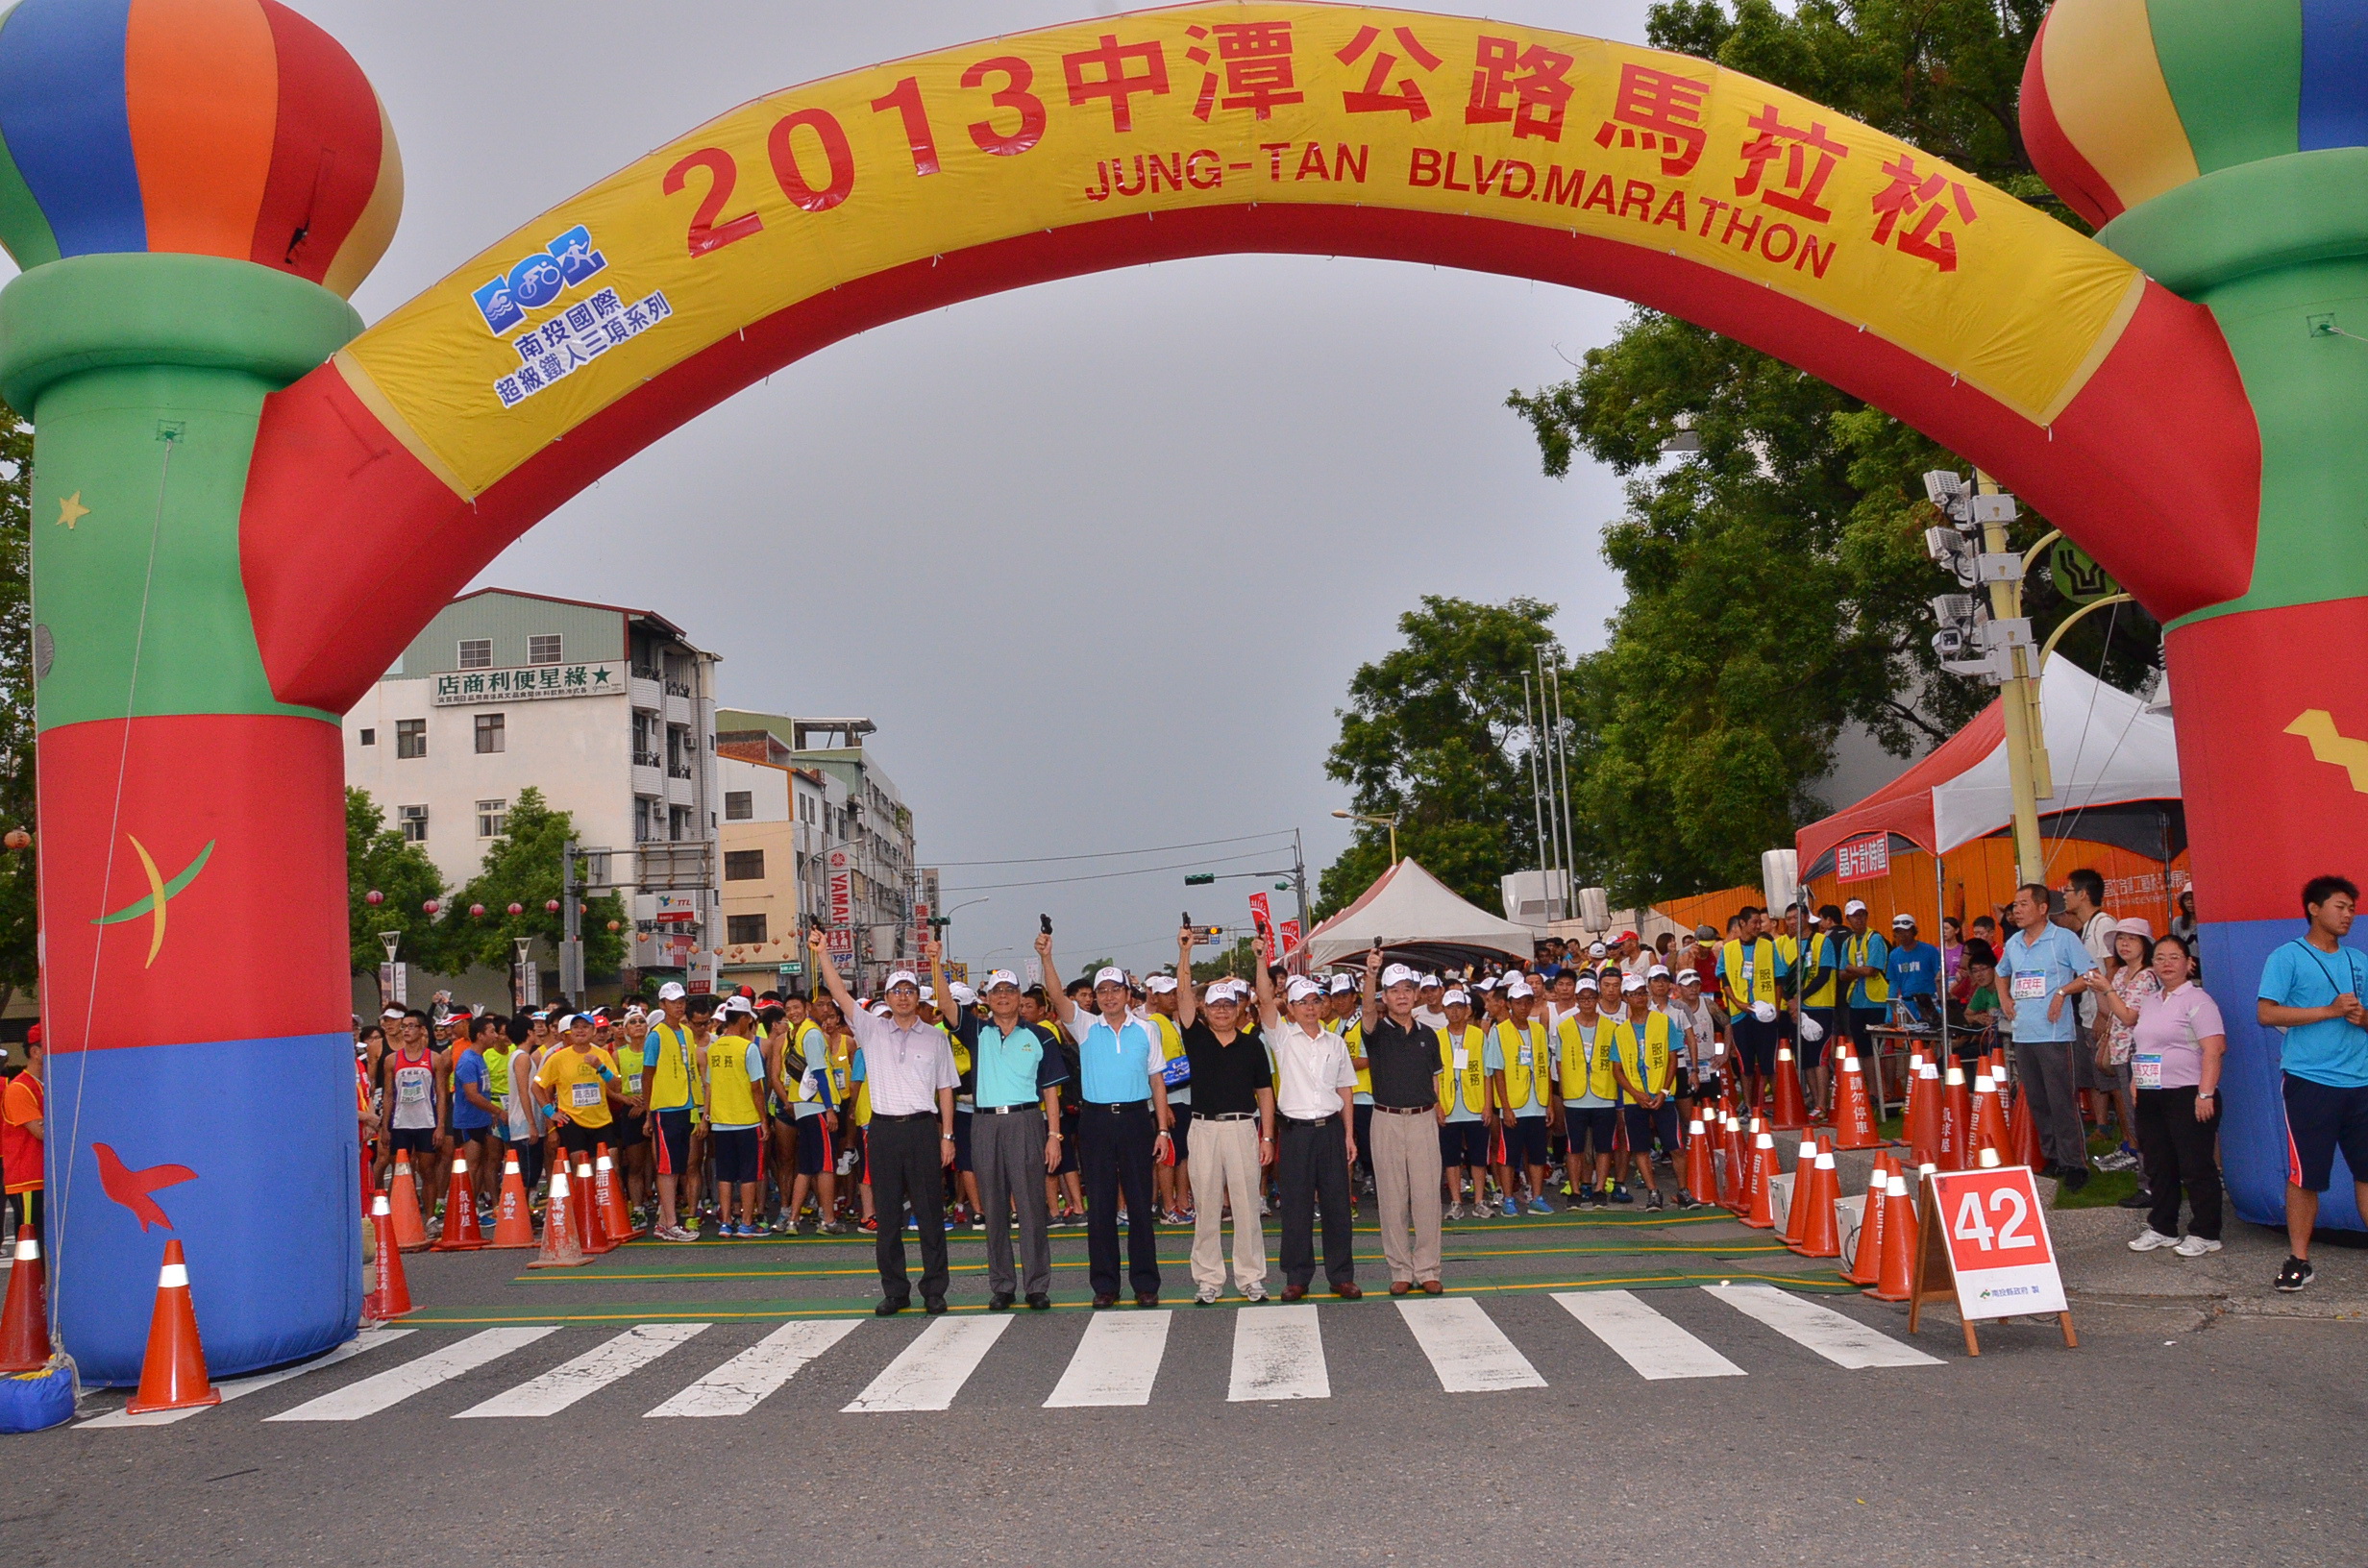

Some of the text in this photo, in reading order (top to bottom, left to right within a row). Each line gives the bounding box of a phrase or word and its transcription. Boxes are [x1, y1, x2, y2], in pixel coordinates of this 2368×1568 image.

[1085, 141, 1369, 203] JUNG-TAN
[514, 288, 622, 362] 南投國際
[495, 291, 671, 406] 超級鐵人三項系列
[678, 898, 692, 907] TTL
[833, 953, 852, 963] YSP
[1759, 968, 1772, 993] 服務
[1468, 1060, 1480, 1087] 服務
[1599, 1044, 1611, 1071] 服務
[1849, 1076, 1869, 1135] 請勿停車
[458, 1189, 472, 1227] 氣球屋
[1954, 1188, 2036, 1251] 42
